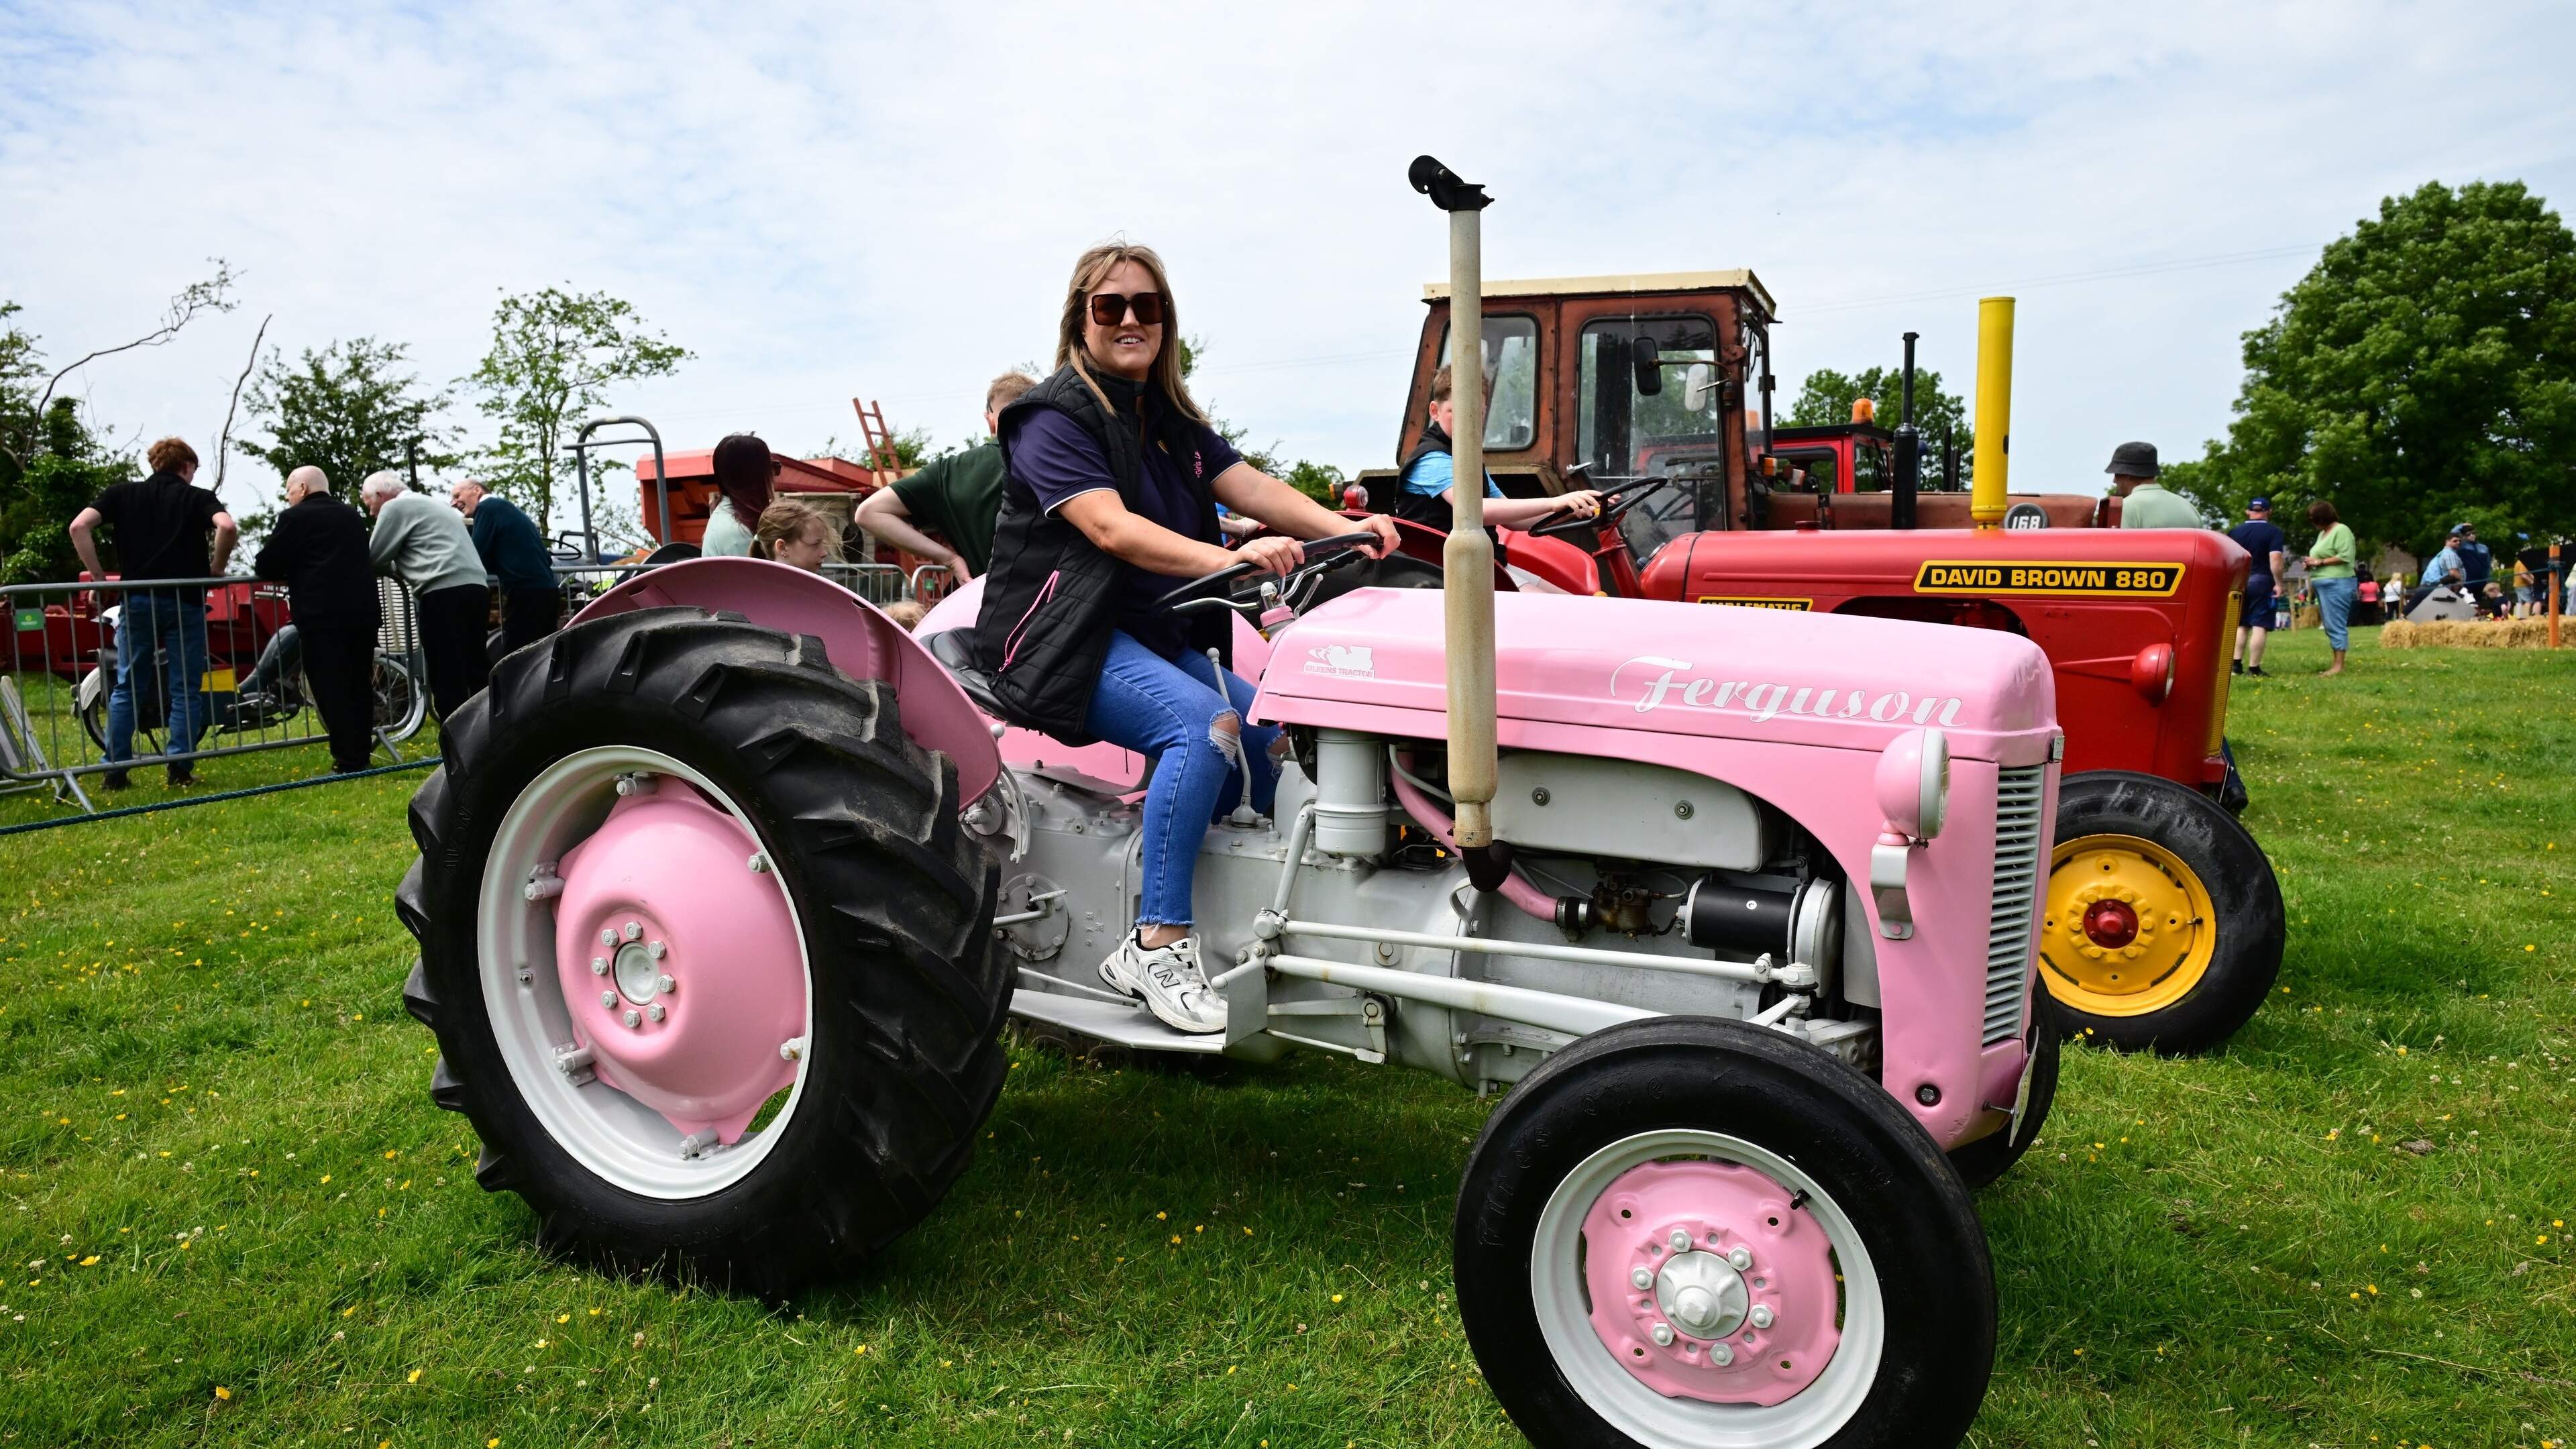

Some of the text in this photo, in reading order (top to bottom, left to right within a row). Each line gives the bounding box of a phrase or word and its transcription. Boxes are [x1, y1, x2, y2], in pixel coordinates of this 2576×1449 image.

[2012, 515, 2041, 529] 168
[1931, 568, 2166, 588] DAVID BROWN 880
[1305, 665, 1373, 678] EILEENS TRACTOR
[1611, 655, 1968, 727] Ferguson
[1154, 969, 1181, 988] N
